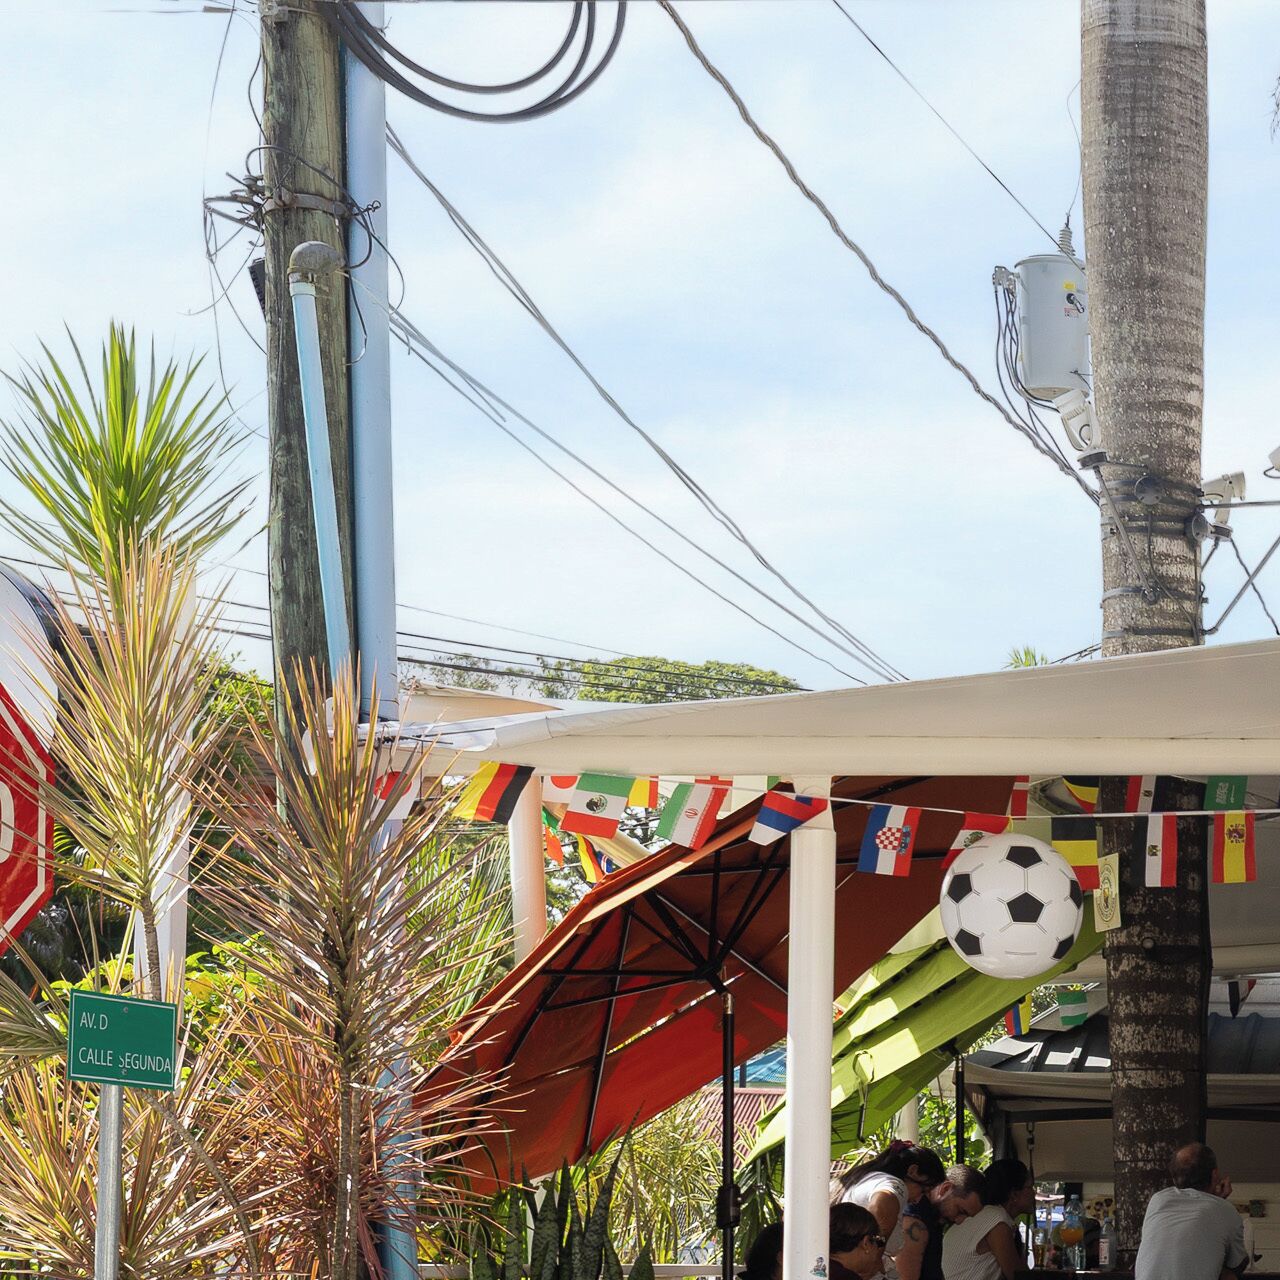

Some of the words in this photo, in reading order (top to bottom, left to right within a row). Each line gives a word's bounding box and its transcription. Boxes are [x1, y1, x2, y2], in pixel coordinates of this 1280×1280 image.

[80, 1012, 97, 1029] AV.
[100, 1014, 108, 1031] D
[78, 1047, 113, 1067] CALLE
[118, 1052, 172, 1073] SEGUNDA
